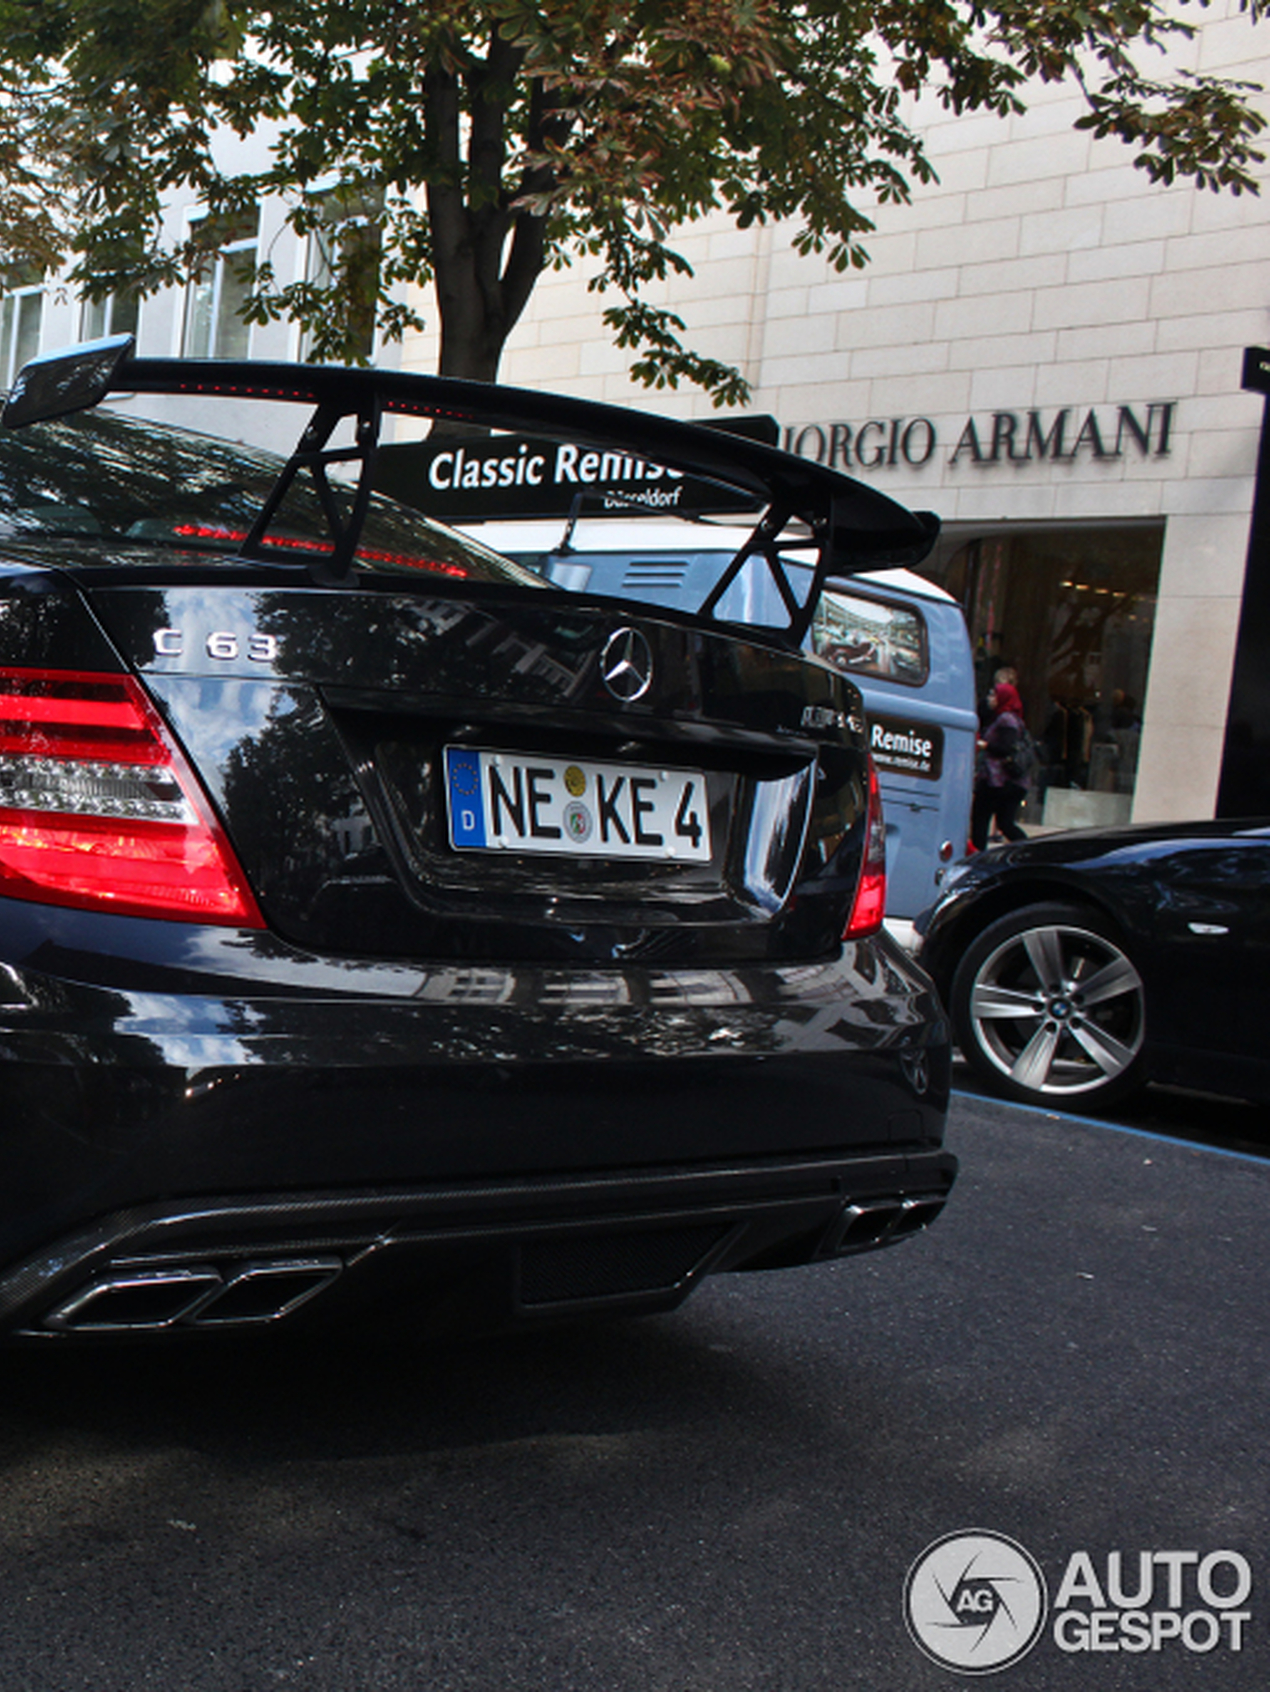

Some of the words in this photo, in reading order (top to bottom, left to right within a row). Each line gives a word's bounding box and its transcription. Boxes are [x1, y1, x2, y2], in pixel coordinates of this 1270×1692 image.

[783, 417, 937, 470] IORGIO
[948, 401, 1178, 466] ARMANI
[430, 444, 545, 490] Classic
[152, 628, 183, 657] C
[206, 631, 279, 663] 63
[871, 724, 933, 757] Remise
[462, 810, 475, 831] D
[488, 764, 562, 840] NE
[596, 773, 664, 846] KE
[674, 781, 703, 848] 4
